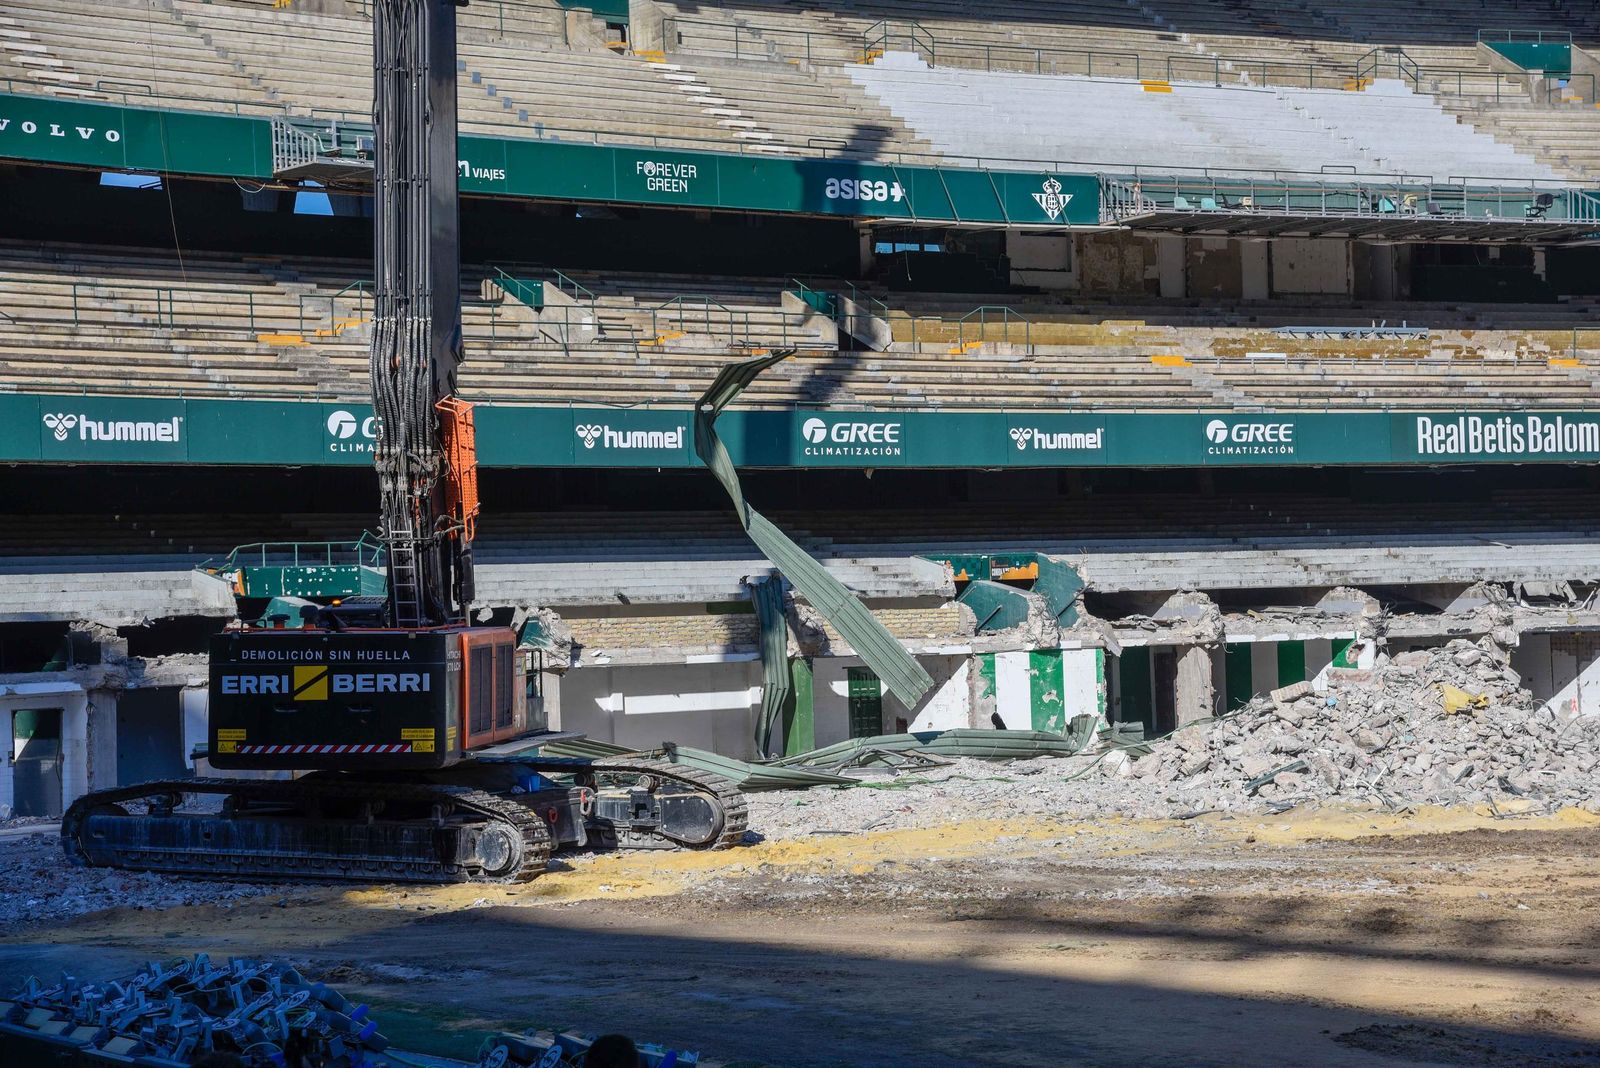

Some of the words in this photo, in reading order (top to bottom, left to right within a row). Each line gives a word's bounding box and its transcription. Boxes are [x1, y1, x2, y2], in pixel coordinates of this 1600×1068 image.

[472, 167, 506, 181] VIAJES
[636, 161, 697, 178] FOREVER
[647, 177, 688, 193] GREEN
[825, 177, 887, 202] asisa
[80, 414, 179, 442] hummel
[604, 425, 683, 449] hummel
[831, 423, 901, 443] GREE
[1231, 423, 1294, 443] GREE
[1416, 416, 1466, 454] Real
[1468, 416, 1525, 454] Betis
[1033, 428, 1101, 450] hummel
[804, 445, 901, 456] CLIMATIZACIÓN
[1208, 444, 1294, 455] CLIMATIZACIÓN
[241, 648, 323, 660] DEMOLICIÓN
[329, 650, 351, 660] SIN
[357, 650, 411, 660] HUELLA
[221, 674, 289, 694] ERRI
[332, 673, 430, 693] BERRI
